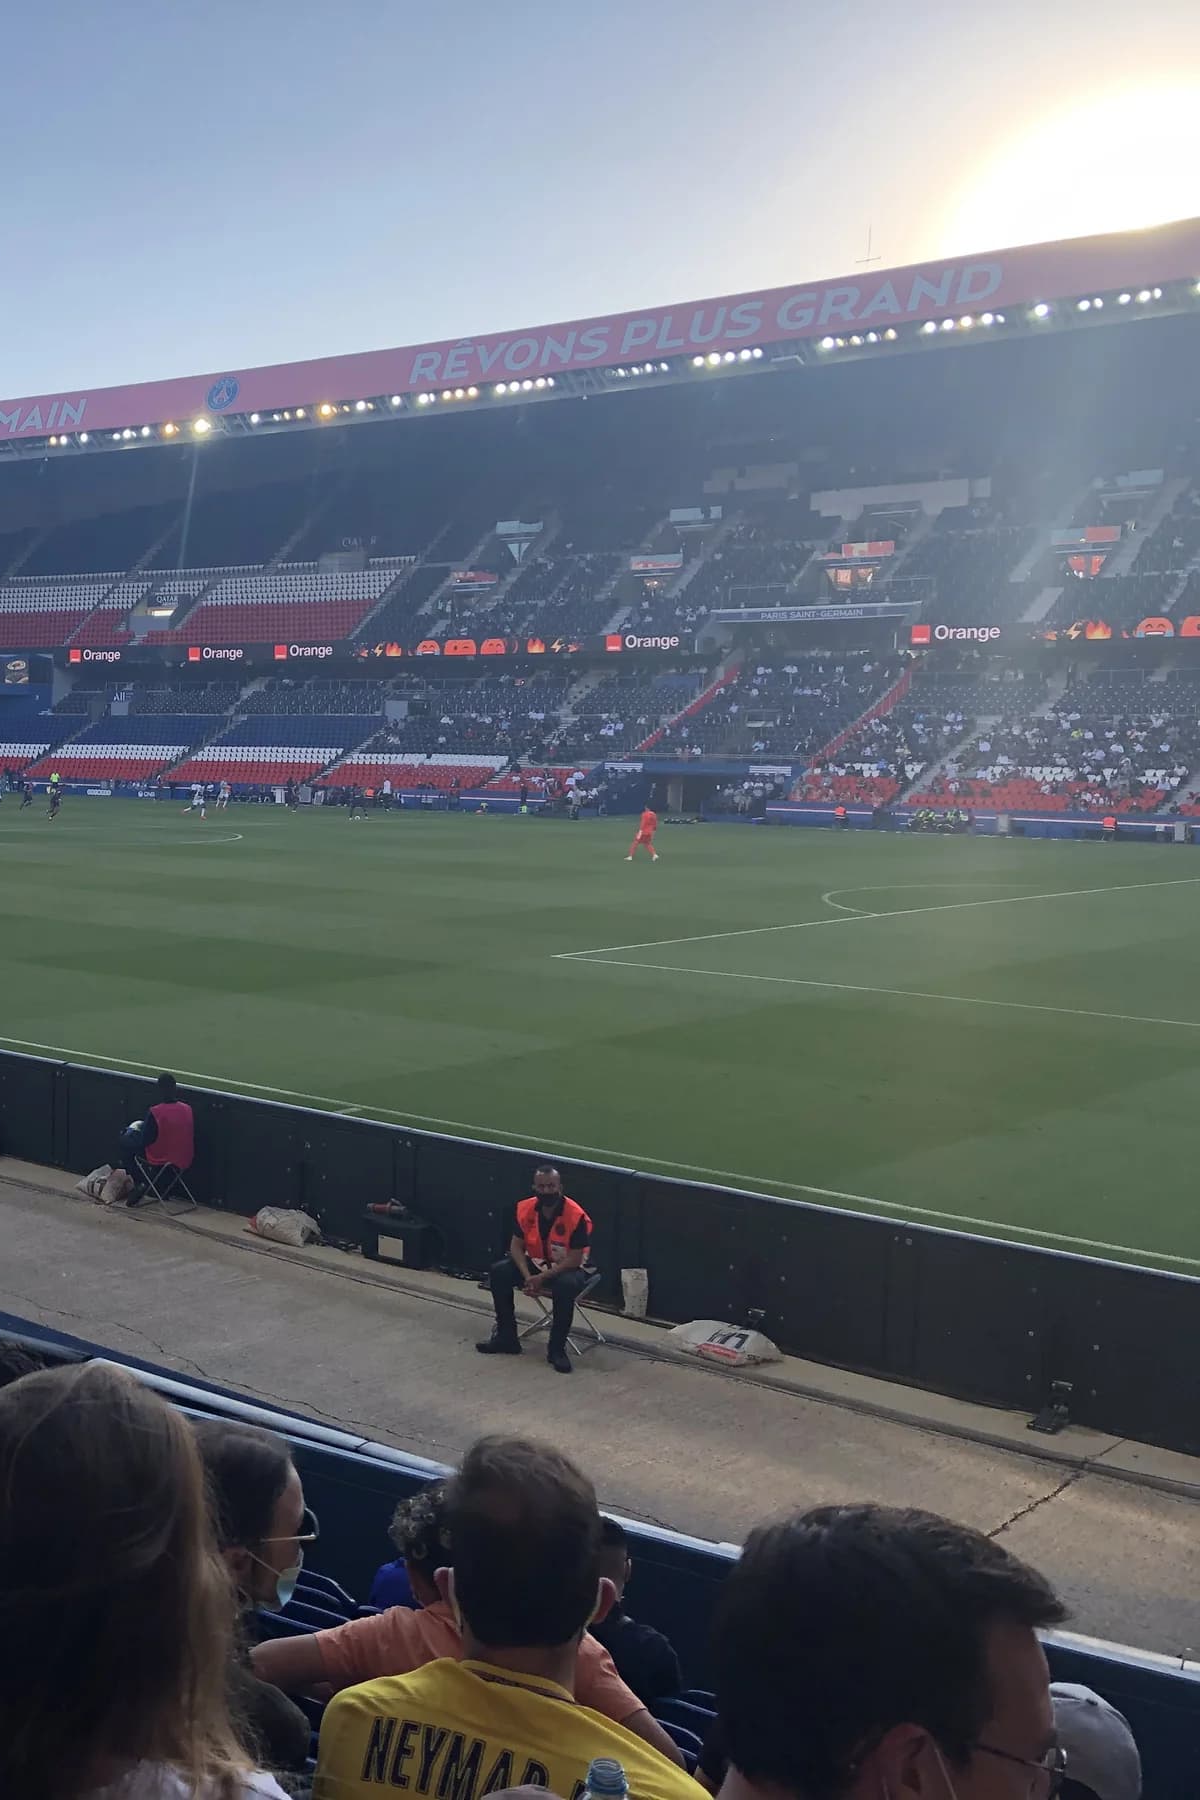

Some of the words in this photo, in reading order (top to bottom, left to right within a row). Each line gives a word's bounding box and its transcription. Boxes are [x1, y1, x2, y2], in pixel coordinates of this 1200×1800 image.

[408, 325, 611, 385] RÊVONS
[620, 300, 763, 356] PLUS
[775, 262, 1003, 331] GRAND
[935, 624, 1001, 643] Orange
[625, 634, 680, 651] Orange
[83, 649, 121, 663] Orange
[203, 647, 243, 660] Orange
[289, 645, 333, 657] Orange
